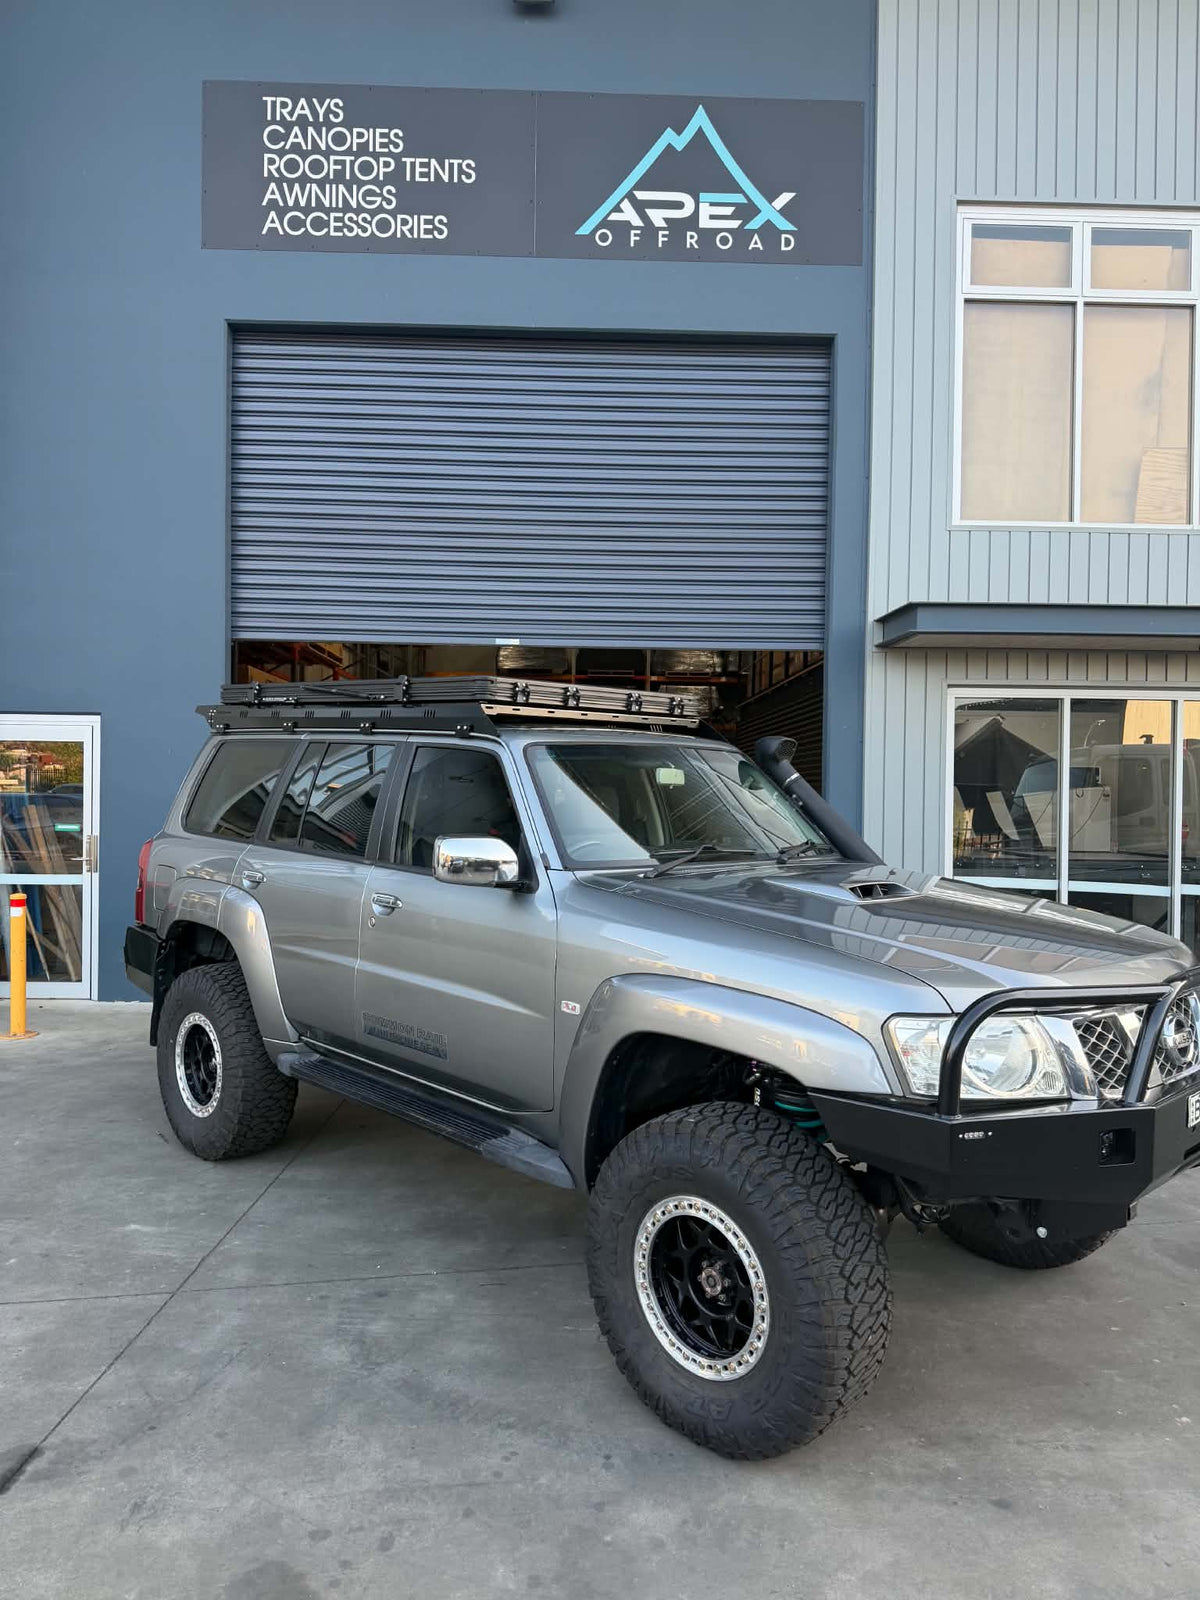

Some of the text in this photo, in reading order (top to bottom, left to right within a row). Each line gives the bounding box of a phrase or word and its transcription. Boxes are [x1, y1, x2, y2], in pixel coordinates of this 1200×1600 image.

[262, 96, 344, 123] TRAYS
[262, 124, 404, 154] CANOPIES
[263, 153, 476, 184] ROOFTOP TENTS
[261, 182, 397, 210] AWNINGS
[603, 190, 798, 231] APEX
[261, 210, 448, 240] ACCESSORIES
[594, 228, 795, 251] OFFROAD
